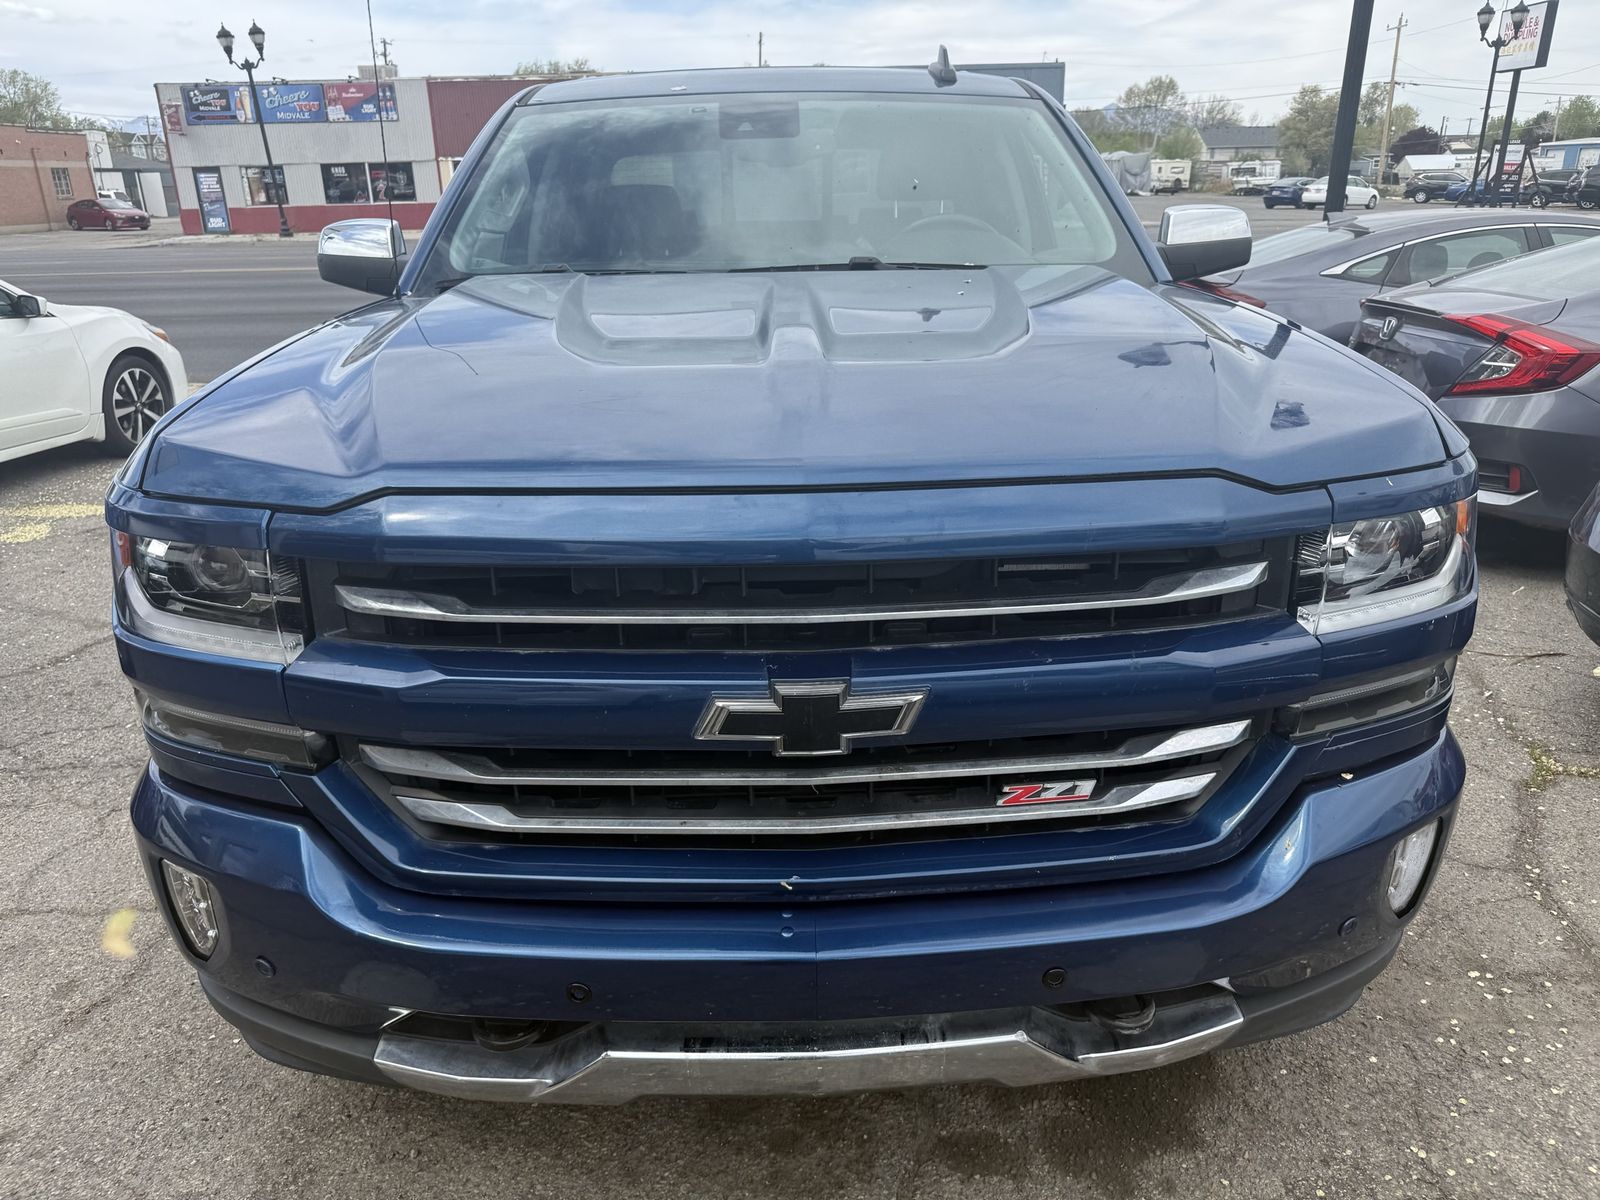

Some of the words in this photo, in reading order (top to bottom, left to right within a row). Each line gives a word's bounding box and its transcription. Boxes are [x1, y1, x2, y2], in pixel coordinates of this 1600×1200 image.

[192, 92, 221, 104] Cheers
[265, 91, 310, 109] Cheers
[276, 111, 311, 119] MIDVALE
[996, 779, 1097, 806] Z71
